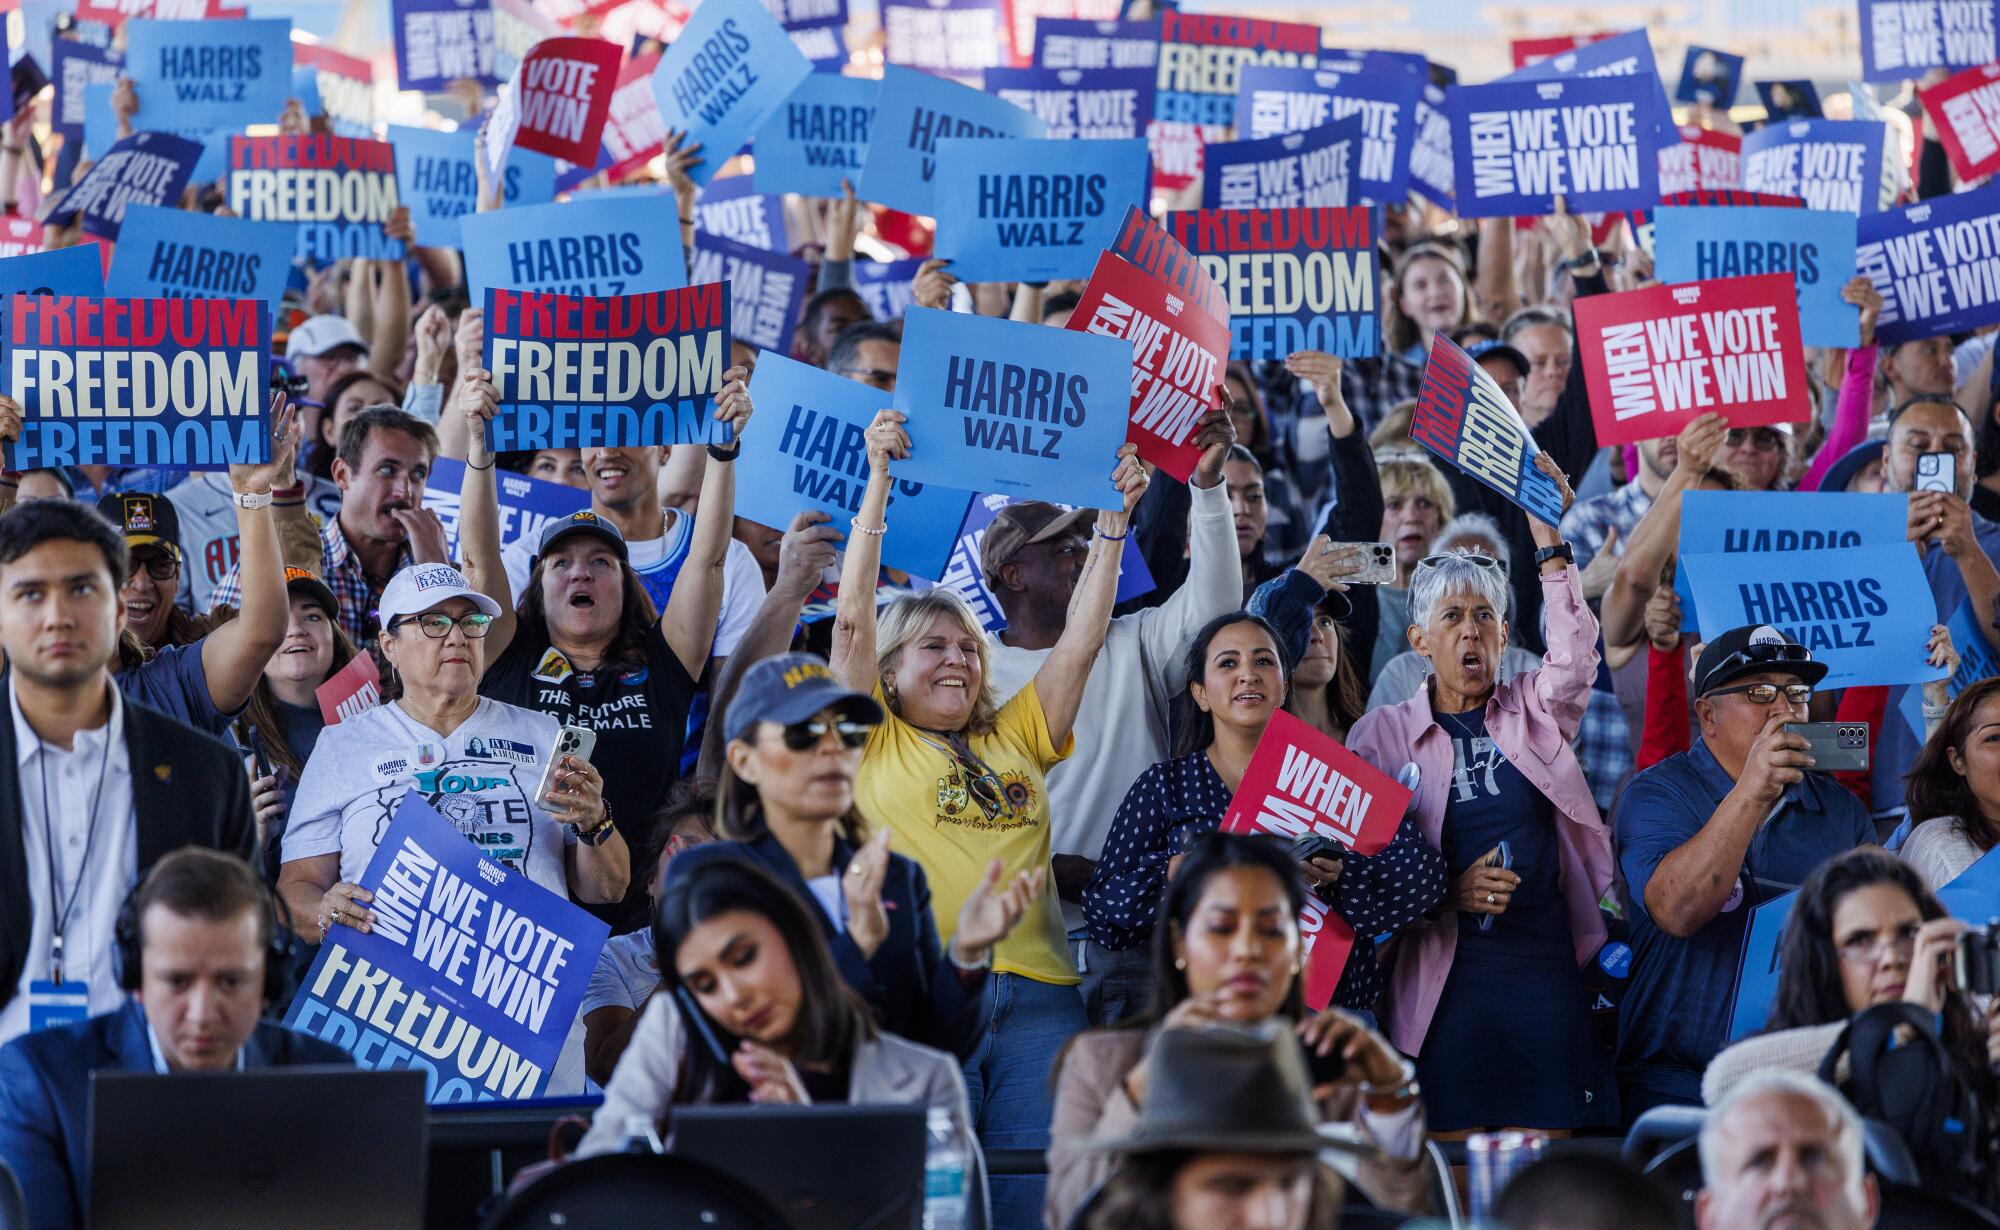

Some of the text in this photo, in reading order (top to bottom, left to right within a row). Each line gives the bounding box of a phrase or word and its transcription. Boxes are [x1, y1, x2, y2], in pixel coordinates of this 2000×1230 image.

[160, 45, 262, 81] HARRIS
[526, 57, 599, 101] VOTE
[672, 18, 751, 118] HARRIS
[175, 82, 246, 103] WALZ
[522, 90, 590, 144] WIN
[700, 63, 759, 126] WALZ
[787, 103, 876, 142] HARR
[1510, 102, 1636, 151] WE VOTE
[414, 156, 521, 201] HARS
[805, 145, 862, 169] WAL
[1259, 156, 1299, 197] WE
[1300, 139, 1352, 192] VOTE
[1359, 138, 1396, 183] IN
[1469, 111, 1515, 198] WHEN
[1512, 145, 1640, 196] WE WIN
[1699, 146, 1740, 179] VOT
[1802, 143, 1866, 181] VOTE
[231, 168, 400, 223] FREEDOM
[978, 174, 1106, 219] HARRIS
[508, 232, 644, 284] HARRIS
[998, 222, 1085, 248] WALZ
[1884, 230, 1938, 278] WE
[148, 241, 262, 294] HARRIS
[1200, 251, 1375, 315] REEDOM
[1696, 240, 1820, 284] HARRIS
[493, 281, 722, 339] FREEDOM
[1085, 292, 1135, 339] EN
[1166, 293, 1185, 312] HARRIS
[1166, 304, 1181, 317] WALZ
[1672, 286, 1701, 300] HARRIS
[1894, 268, 1952, 322] WE
[12, 295, 258, 348] FREEDOM
[1646, 306, 1782, 364] WE VOTE
[491, 330, 724, 402] FREEDOM
[1126, 309, 1218, 403] WE VOTE
[1602, 321, 1657, 422] WHEN
[11, 349, 260, 418] FREEDOM
[944, 355, 1089, 428] HARRIS
[1651, 351, 1788, 412] WE WIN
[1130, 378, 1209, 448] WIN
[15, 420, 261, 471] FREEDOM
[963, 416, 1063, 460] WALZ
[1738, 577, 1889, 626] HARRIS
[539, 689, 571, 707] THE
[579, 694, 648, 719] FUTURE
[566, 713, 653, 731] FEMALE
[377, 759, 408, 772] HARRIS
[492, 749, 535, 764] KAMALA ERA
[501, 739, 514, 751] MY
[383, 767, 405, 776] WALZ
[1275, 744, 1373, 837] WHEN
[370, 836, 440, 947] WHEN
[478, 857, 507, 883] HARRIS
[479, 869, 501, 887] WALZ
[425, 864, 576, 988] WE VOTE
[412, 908, 556, 1035] WE WIN
[311, 943, 543, 1102] FREEDOM
